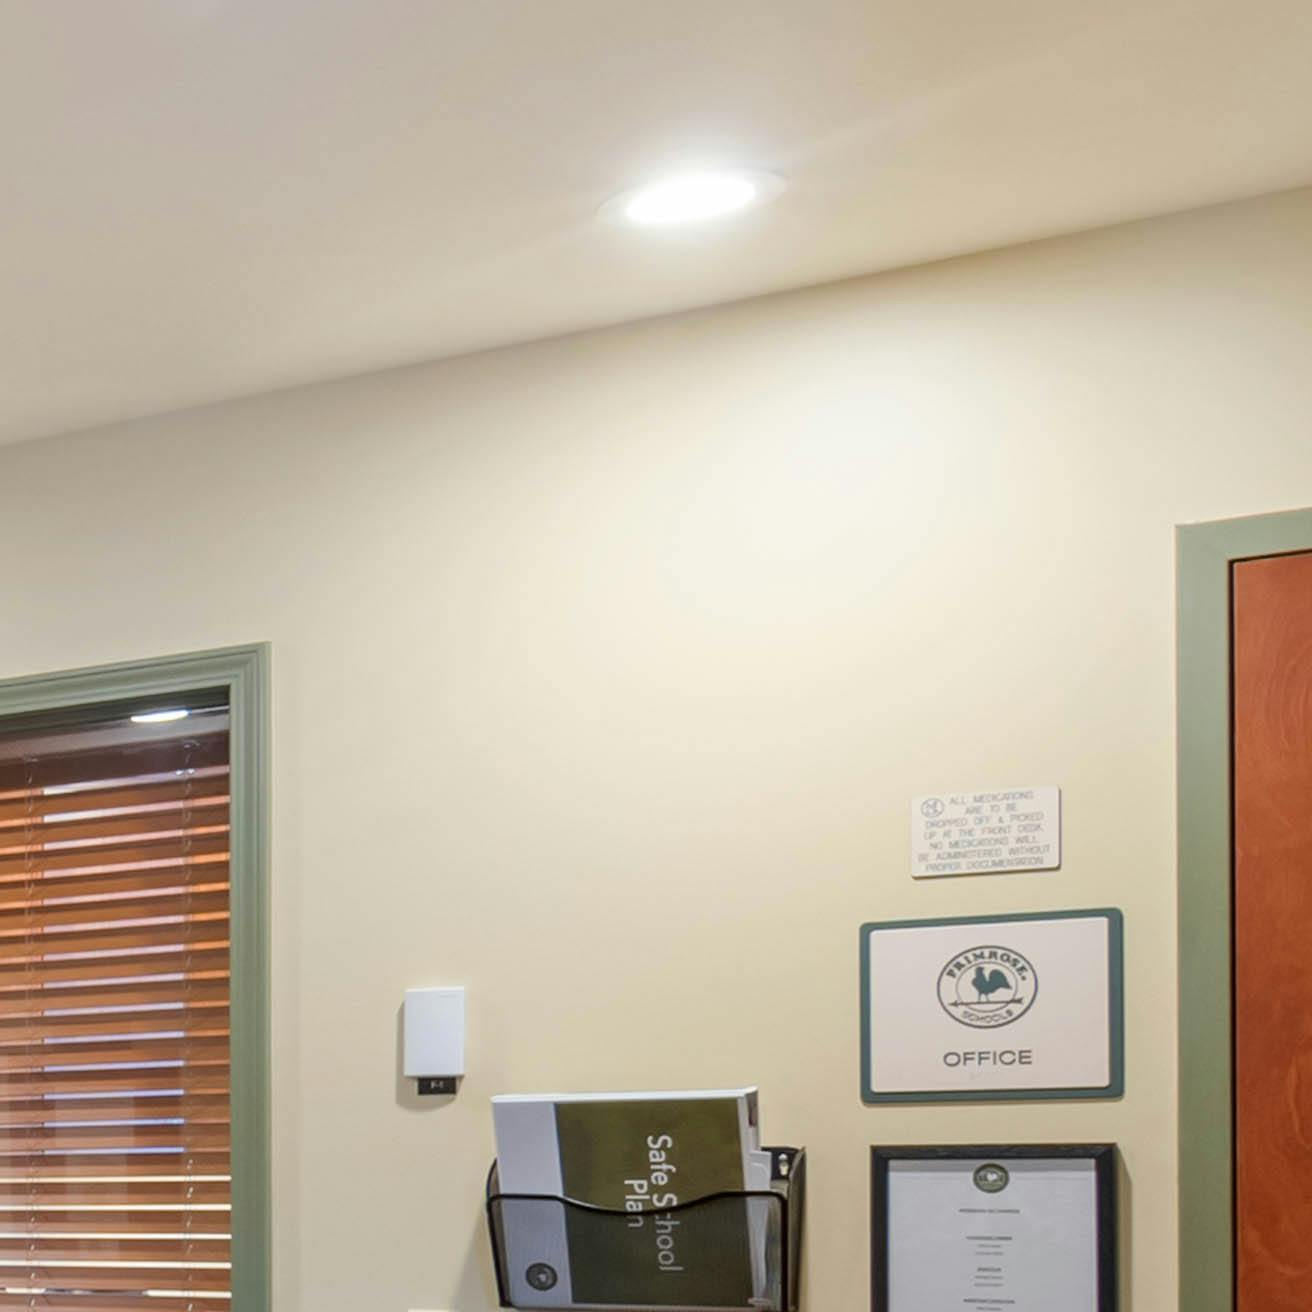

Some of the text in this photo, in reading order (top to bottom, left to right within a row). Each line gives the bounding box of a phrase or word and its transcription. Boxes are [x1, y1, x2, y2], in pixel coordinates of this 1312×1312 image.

[973, 791, 1035, 803] MEDICATIONS
[925, 817, 968, 828] DROPPED
[982, 825, 1012, 835] FRONT
[948, 837, 1009, 848] MEDICATIONS
[936, 848, 1003, 860] ADMINISTERED
[1008, 844, 1050, 856] WITHOUT
[962, 1009, 1014, 1023] SCHOOLS
[943, 1049, 1033, 1067] OFFICE
[647, 1135, 676, 1185] Safe
